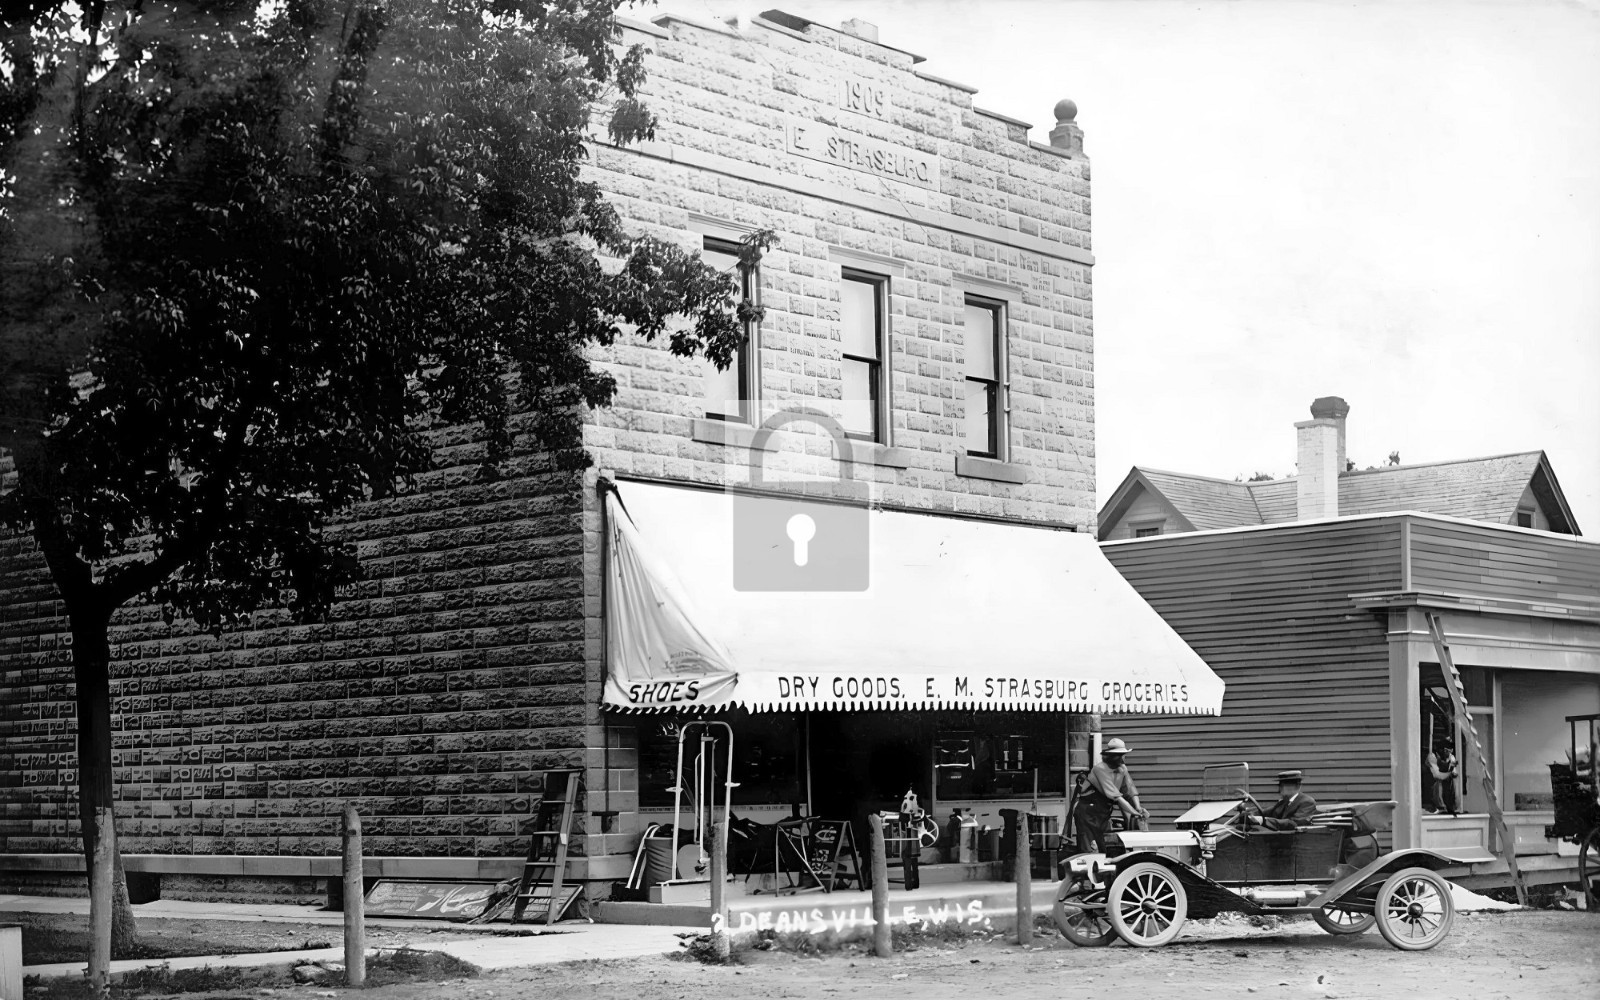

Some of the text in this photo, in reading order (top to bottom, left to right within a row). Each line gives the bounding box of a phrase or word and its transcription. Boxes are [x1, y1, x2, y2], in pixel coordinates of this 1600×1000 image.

[845, 80, 884, 117] 1909
[628, 680, 700, 704] SHOES
[778, 676, 819, 698] DRY
[925, 677, 941, 699] E.
[954, 676, 974, 698] M.
[984, 677, 1088, 700] STRASBURG
[1102, 682, 1189, 702] GROCERIES
